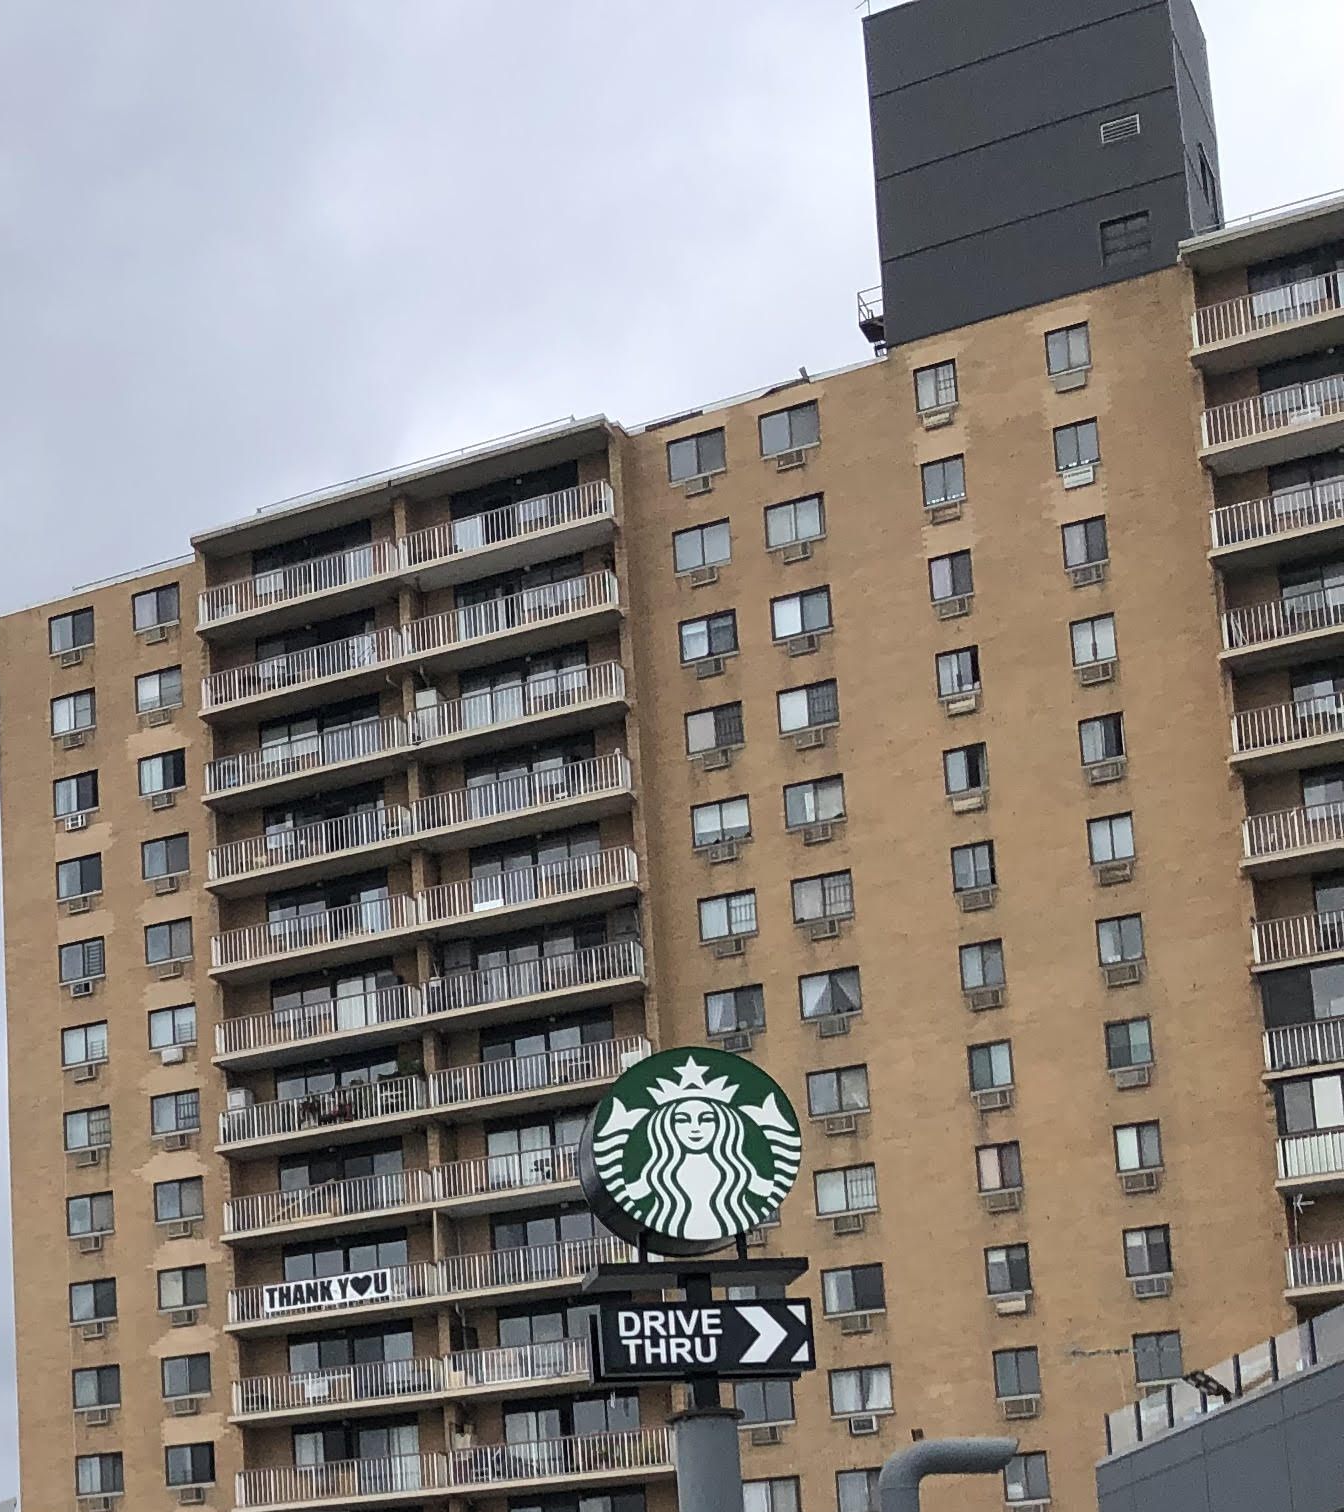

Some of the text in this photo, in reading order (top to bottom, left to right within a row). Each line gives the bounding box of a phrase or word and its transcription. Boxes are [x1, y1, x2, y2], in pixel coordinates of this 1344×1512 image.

[266, 1280, 334, 1309] THANK
[617, 1308, 724, 1338] DRIVE
[621, 1338, 718, 1365] THRU
